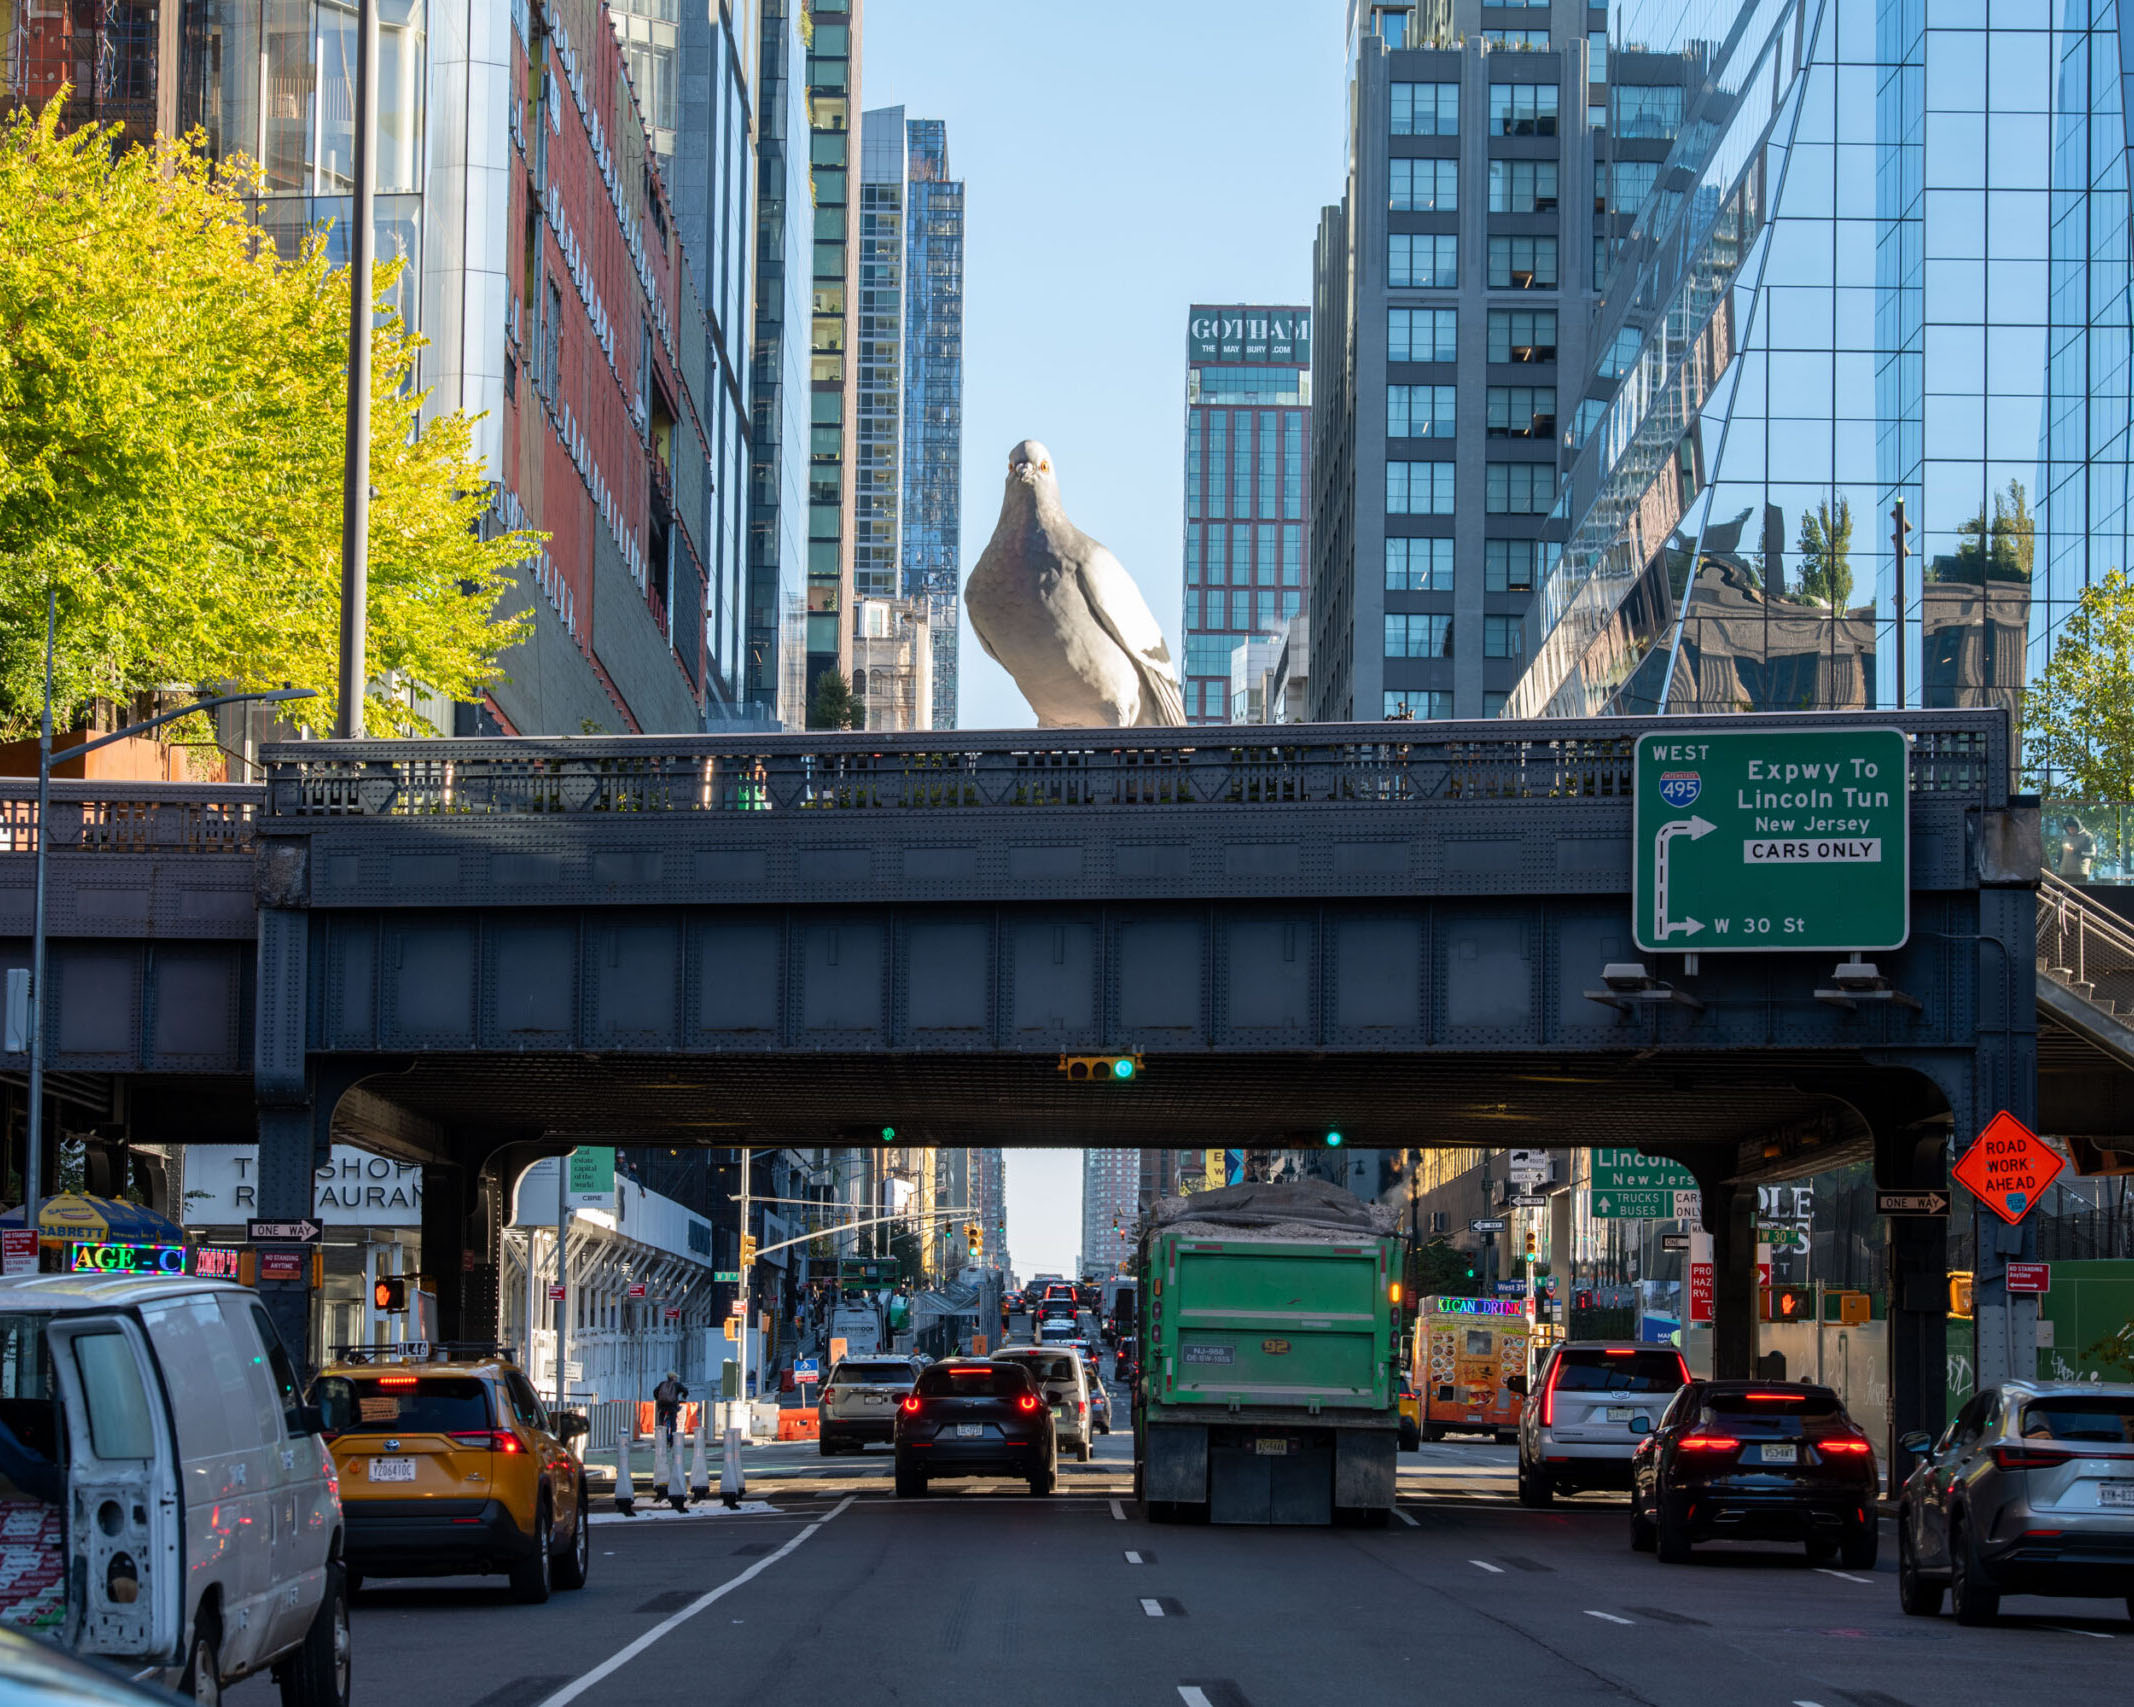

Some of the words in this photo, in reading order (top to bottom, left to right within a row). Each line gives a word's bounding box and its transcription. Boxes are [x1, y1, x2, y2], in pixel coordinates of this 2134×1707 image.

[1191, 318, 1310, 340] GOTHAM
[1202, 345, 1216, 353] THE
[1223, 345, 1240, 353] MAY
[1246, 346, 1266, 354] BURY
[1652, 745, 1710, 761] WEST
[1747, 760, 1841, 784] Expwy
[1850, 758, 1879, 779] To
[1663, 781, 1697, 799] 495
[1737, 789, 1834, 809] Lincoln
[1842, 787, 1890, 808] Tun
[1755, 816, 1796, 833] New
[1803, 816, 1871, 834] Jersey
[1752, 843, 1810, 859] CARS
[1817, 842, 1874, 858] ONLY
[1714, 918, 1730, 934] W
[1743, 918, 1771, 934] 30
[1783, 918, 1806, 933] St
[1986, 1140, 2027, 1155] ROAD
[1988, 1158, 2029, 1173] WORK
[1613, 1173, 1650, 1185] New
[1985, 1176, 2036, 1193] AHEAD
[1617, 1193, 1659, 1203] TRUCKS
[1886, 1198, 1907, 1208] ONE
[1918, 1198, 1940, 1207] WAY
[1620, 1206, 1657, 1216] BUSES
[39, 1225, 104, 1238] SABRETT
[257, 1226, 279, 1236] ONE
[289, 1225, 312, 1236] WAY
[1762, 1231, 1770, 1240] W
[1774, 1230, 1787, 1243] 30
[75, 1247, 136, 1269] AGE
[159, 1251, 181, 1271] C
[1693, 1266, 1712, 1276] PRO
[1498, 1283, 1515, 1292] West
[1693, 1278, 1712, 1287] HAZ
[1264, 1340, 1289, 1353] 92
